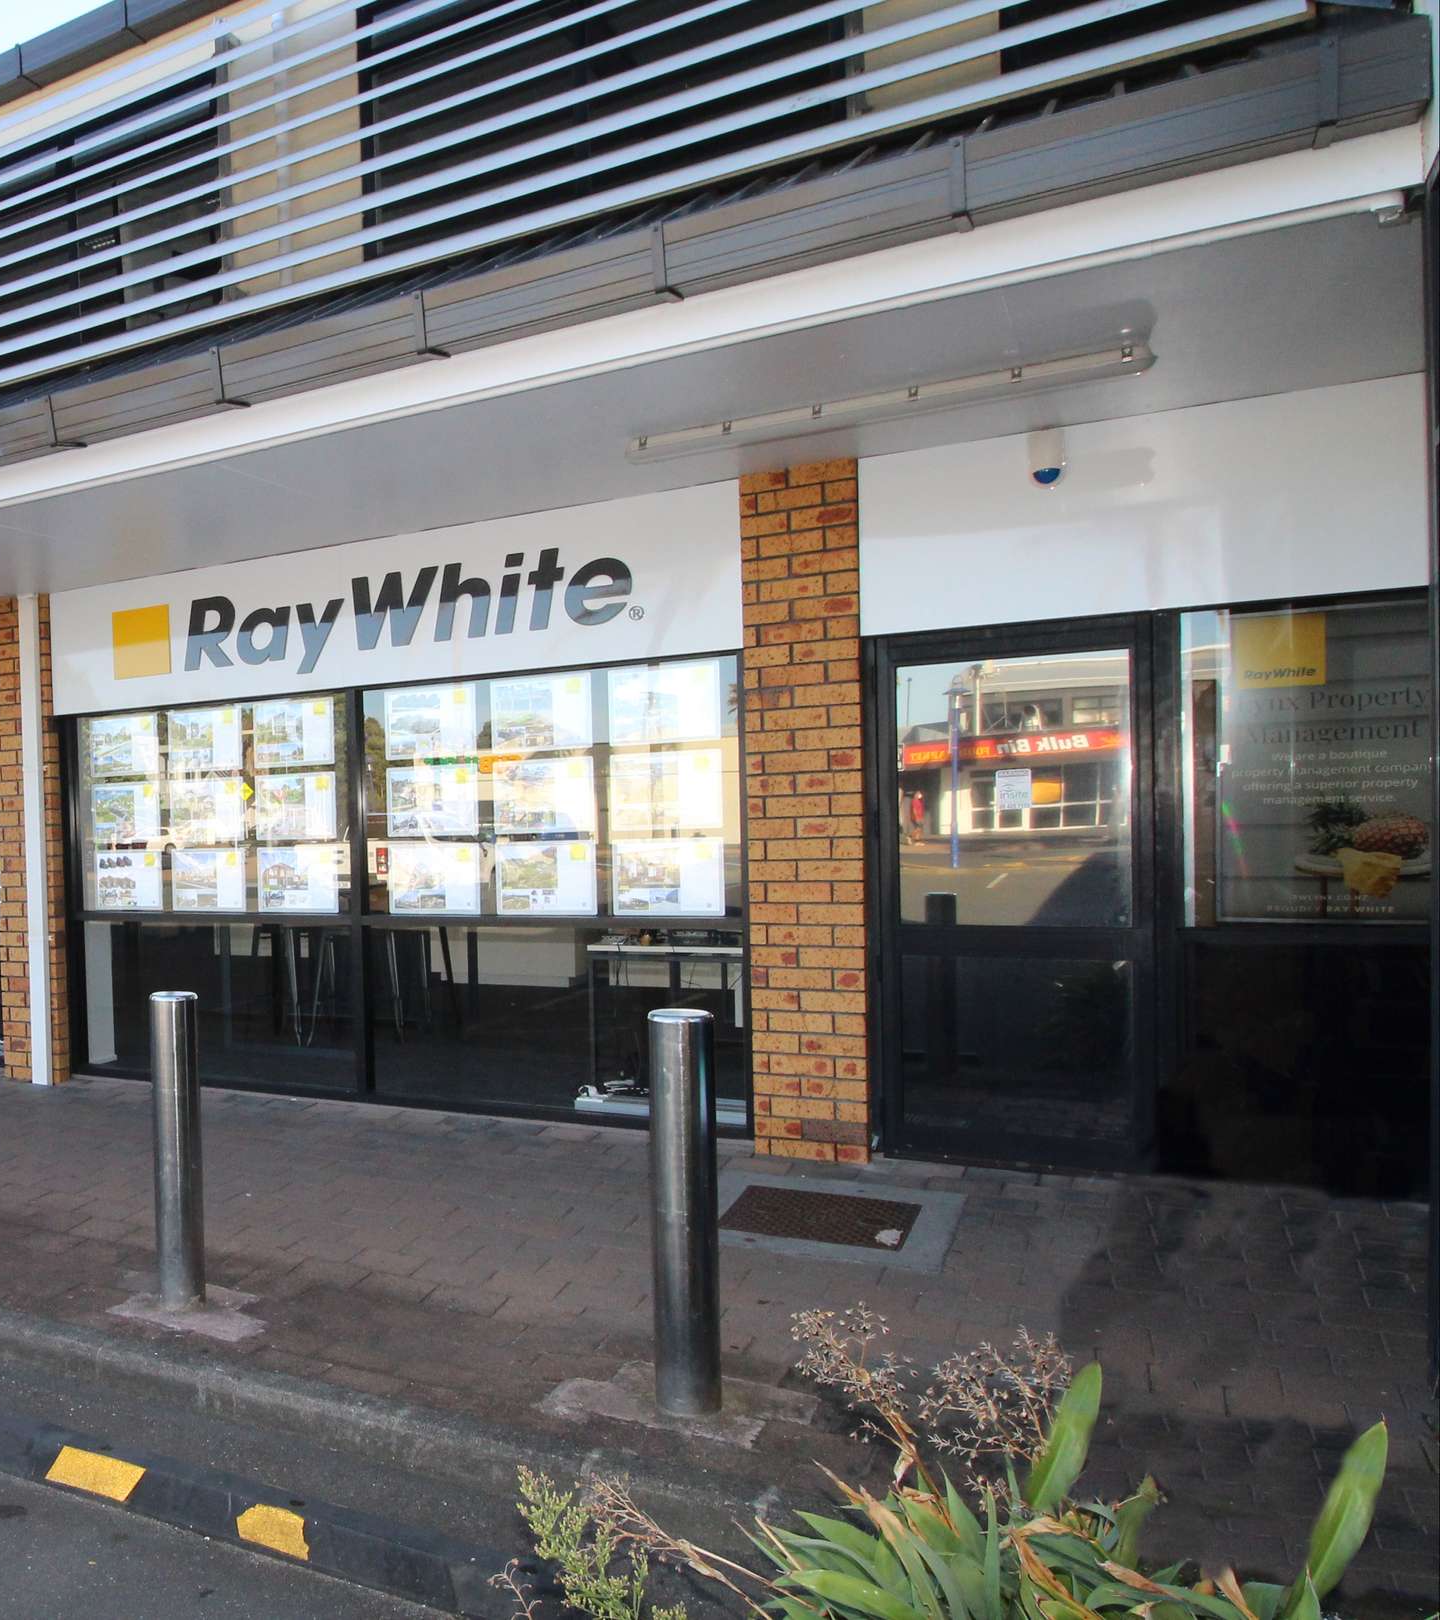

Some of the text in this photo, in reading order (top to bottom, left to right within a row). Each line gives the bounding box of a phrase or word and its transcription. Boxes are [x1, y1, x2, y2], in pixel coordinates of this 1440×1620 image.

[1243, 667, 1317, 681] RayWhite
[1310, 687, 1428, 711] Property
[1247, 718, 1420, 745] Management
[1329, 748, 1388, 760] boutique
[1231, 767, 1285, 779] property
[1288, 764, 1372, 778] management
[1242, 781, 1292, 793] offering
[1305, 779, 1359, 791] superior
[1362, 776, 1419, 790] property
[1264, 793, 1348, 807] management
[1354, 905, 1396, 913] WHITE
